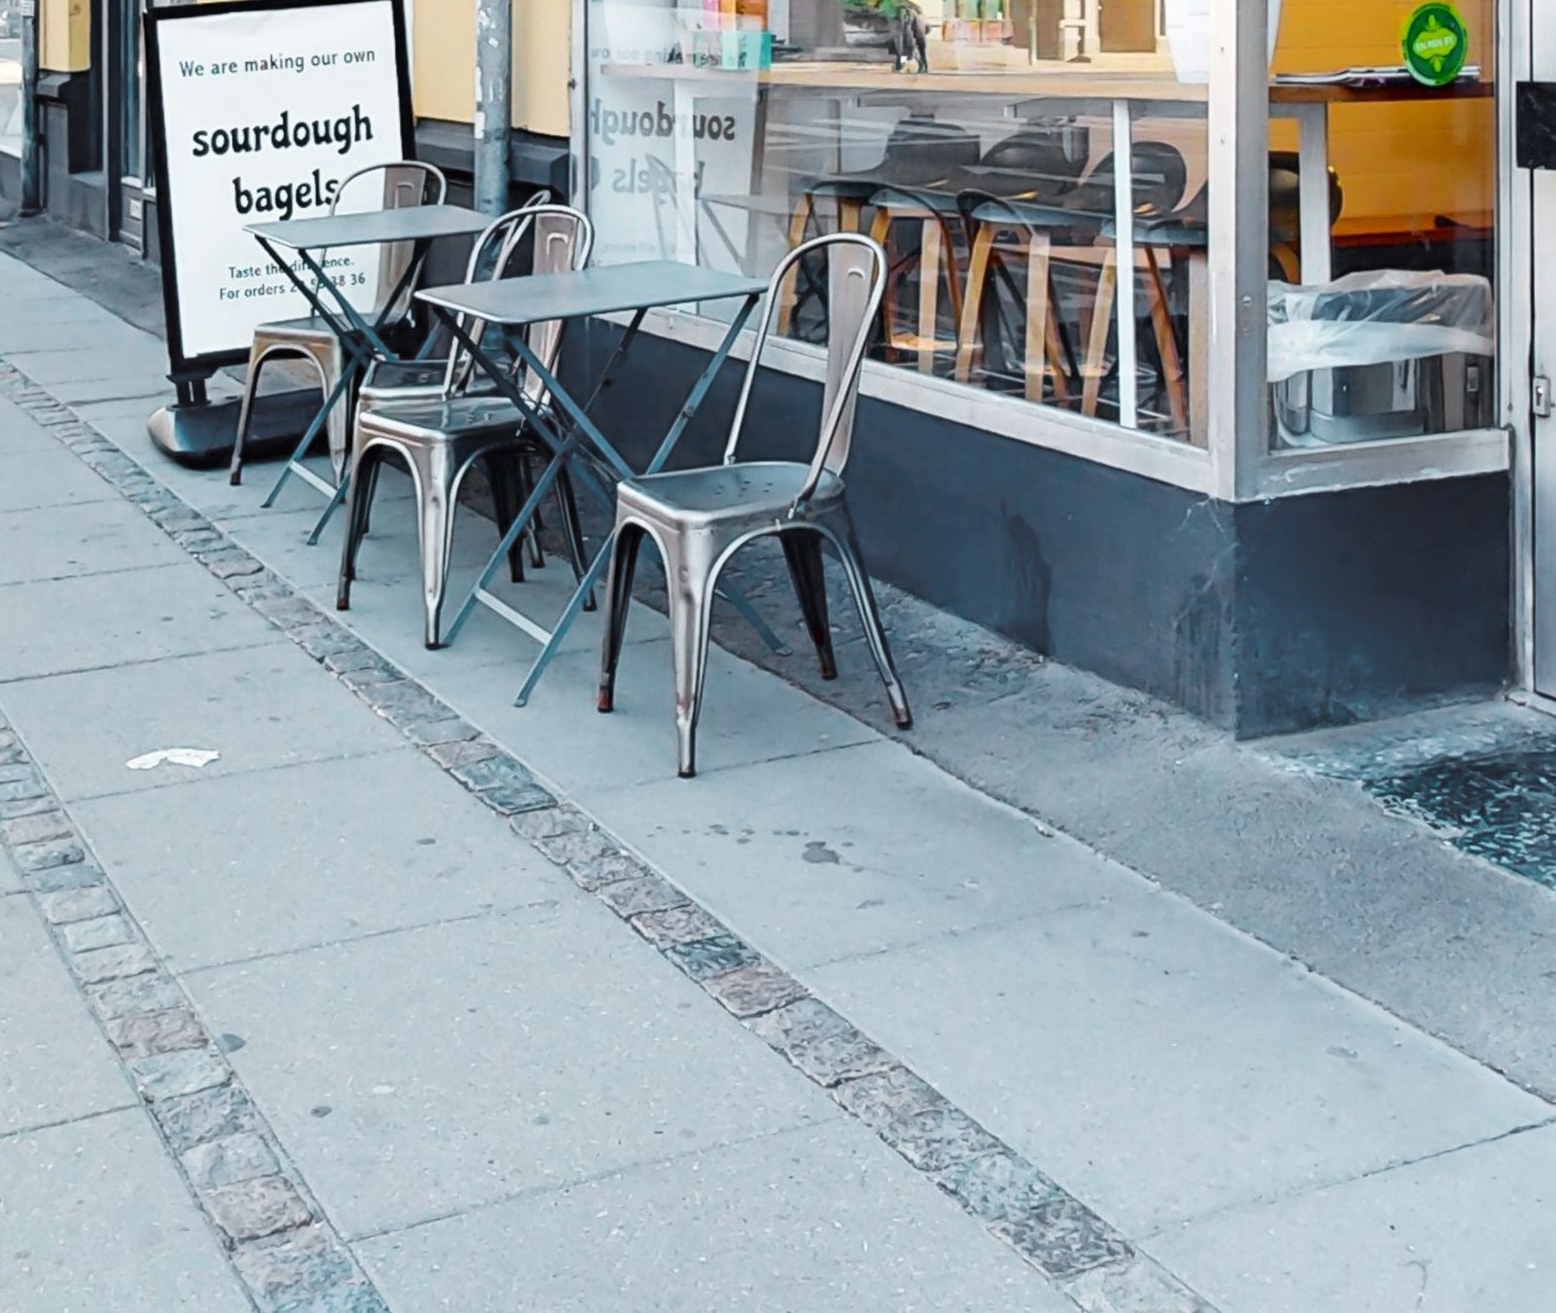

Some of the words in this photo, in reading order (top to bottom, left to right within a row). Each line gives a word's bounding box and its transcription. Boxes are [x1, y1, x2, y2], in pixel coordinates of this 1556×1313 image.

[179, 60, 205, 77] We
[210, 59, 238, 75] are
[244, 53, 305, 73] making
[310, 54, 338, 67] our
[343, 49, 376, 64] own
[191, 104, 374, 157] sourdough
[232, 169, 341, 221] bagels
[219, 288, 240, 300] For
[244, 284, 286, 299] orders
[351, 272, 366, 286] 36
[228, 266, 262, 279] Taste
